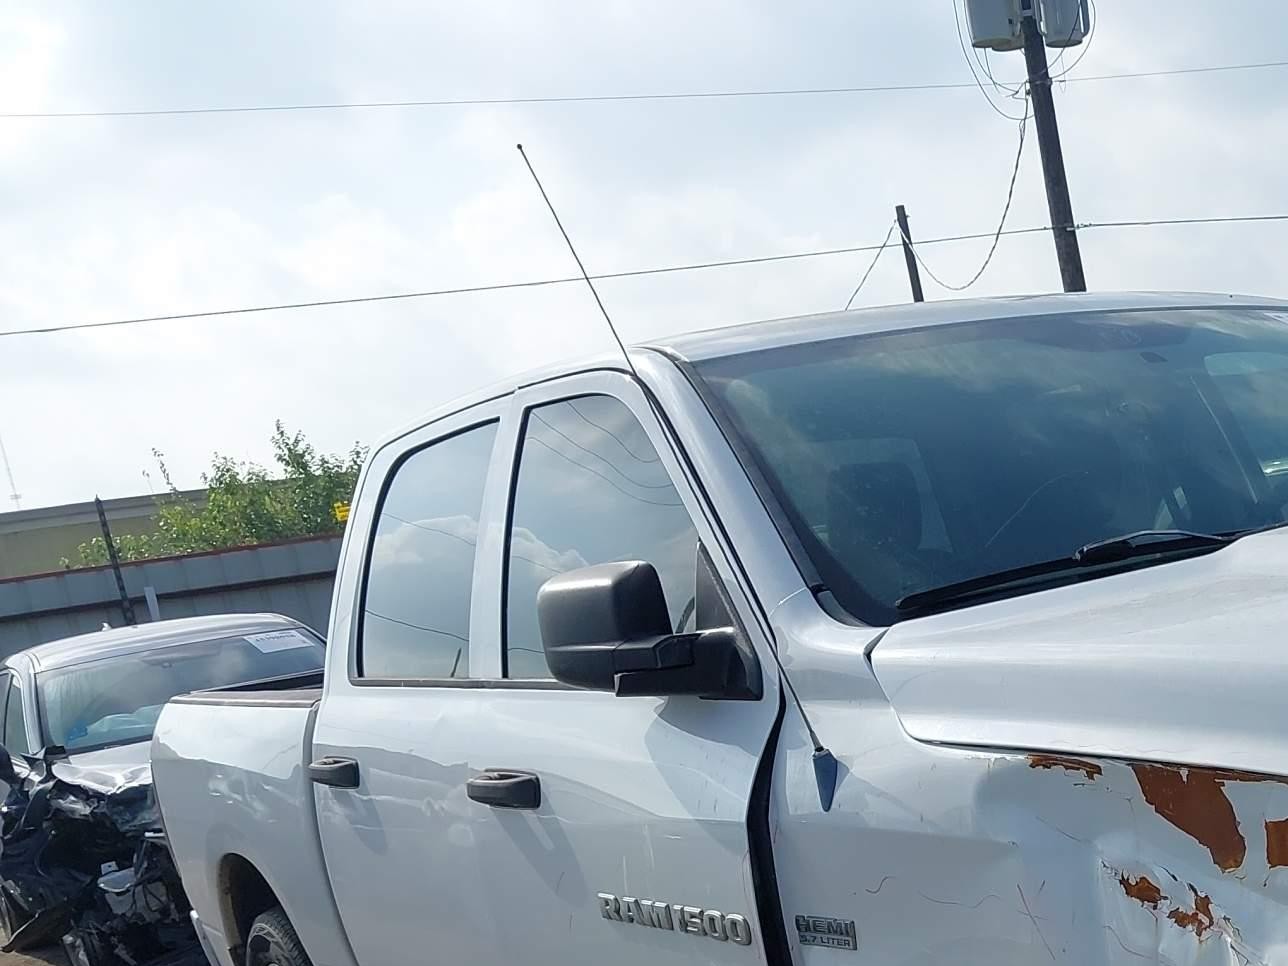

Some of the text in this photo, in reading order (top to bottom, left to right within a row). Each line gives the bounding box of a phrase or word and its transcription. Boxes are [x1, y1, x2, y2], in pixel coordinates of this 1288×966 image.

[597, 891, 752, 946] RAM 1500
[796, 915, 852, 938] HEMI
[819, 936, 851, 947] LITER
